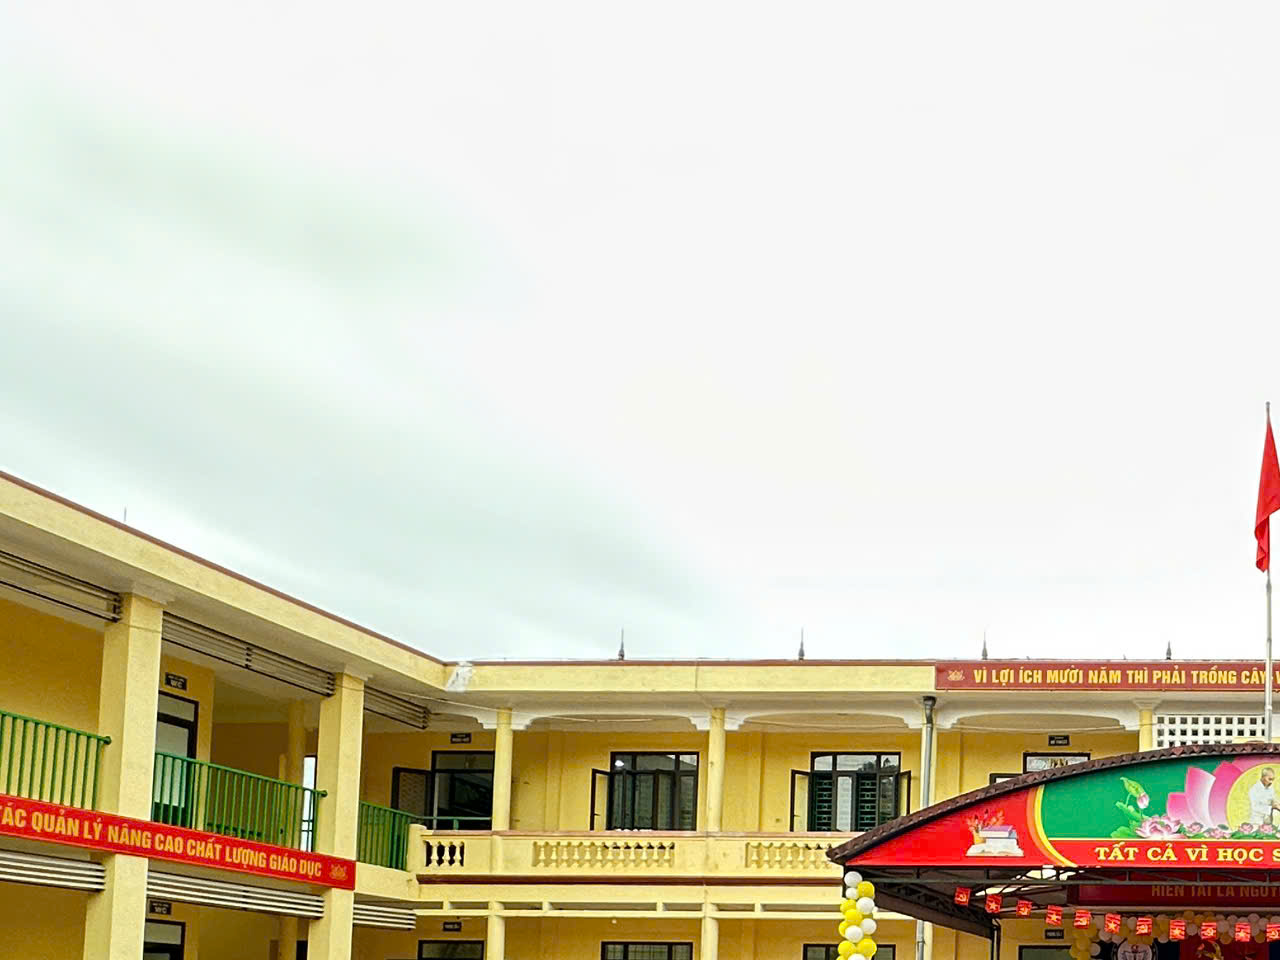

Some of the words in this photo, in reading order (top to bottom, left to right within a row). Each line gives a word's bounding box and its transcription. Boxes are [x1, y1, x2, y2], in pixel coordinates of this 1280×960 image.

[974, 667, 987, 683] VÌ
[992, 669, 1014, 686] LỢI
[1019, 666, 1042, 683] ÍCH
[1047, 665, 1083, 683] MƯỜI
[1088, 665, 1121, 683] NĂM
[1127, 667, 1148, 683] THÌ
[1153, 666, 1186, 684] PHẢI
[1191, 664, 1237, 684] TRỒNG
[1241, 667, 1266, 684] CÂY
[0, 802, 27, 828] ÁC
[31, 807, 79, 838] QUẢN
[84, 817, 102, 841] LÝ
[108, 824, 152, 850] NÂNG
[154, 834, 184, 855] CAO
[186, 837, 223, 861] CHẤT
[226, 846, 267, 869] LƯỢNG
[269, 851, 298, 873] GIÁO
[299, 858, 322, 877] DỤC
[1095, 841, 1138, 861] TẤT
[1146, 842, 1178, 862] CẢ
[1186, 842, 1209, 862] VÌ
[1217, 848, 1264, 865] HỌC
